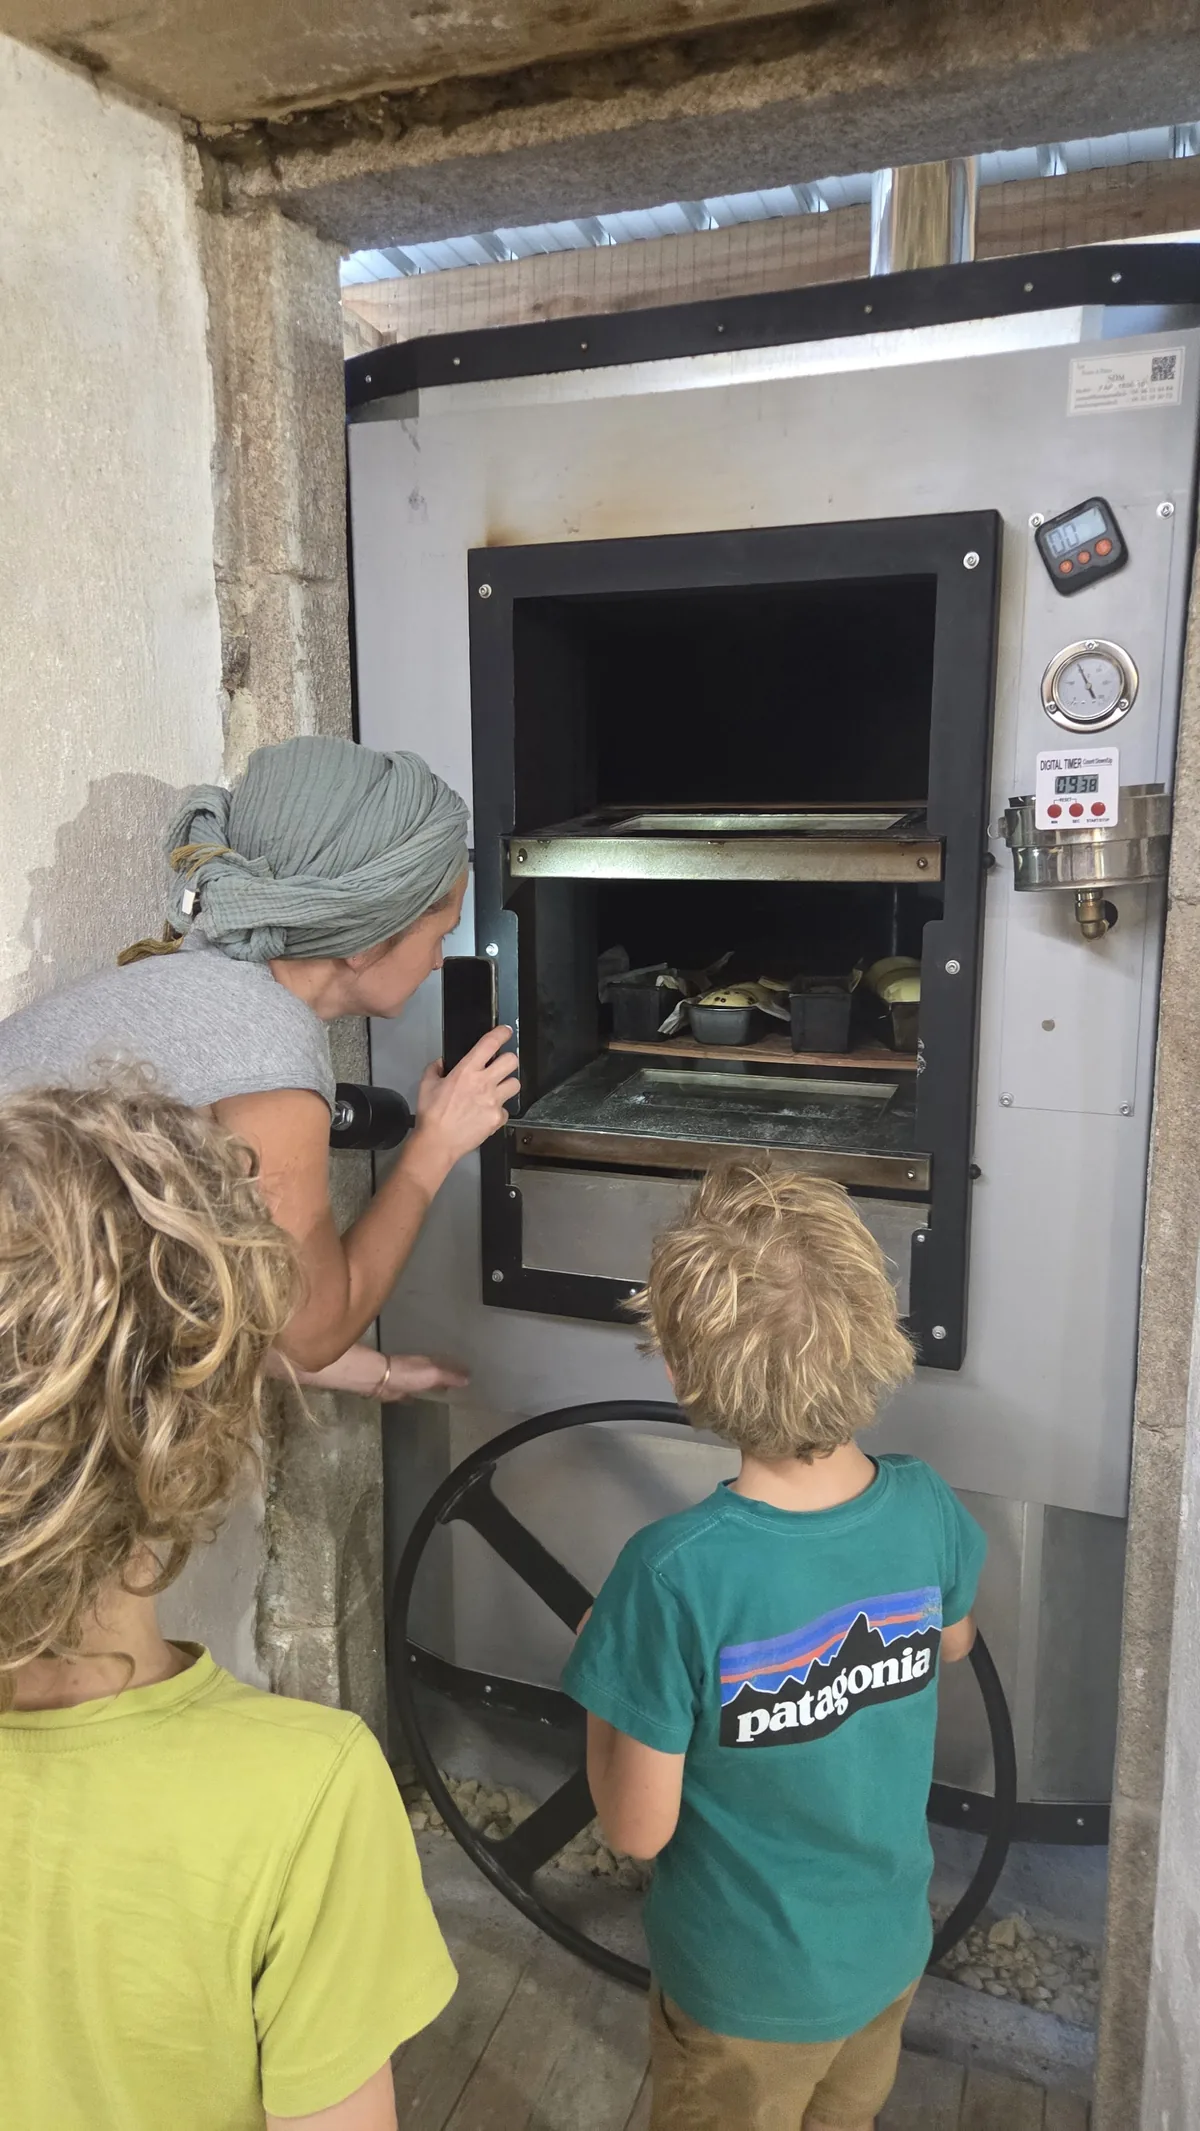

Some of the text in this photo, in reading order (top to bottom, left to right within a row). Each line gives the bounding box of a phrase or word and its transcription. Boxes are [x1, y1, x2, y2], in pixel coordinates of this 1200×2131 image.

[1040, 759, 1063, 771] DIGITAL
[1064, 757, 1082, 770] TIMER
[736, 1647, 931, 1743] patagonia
